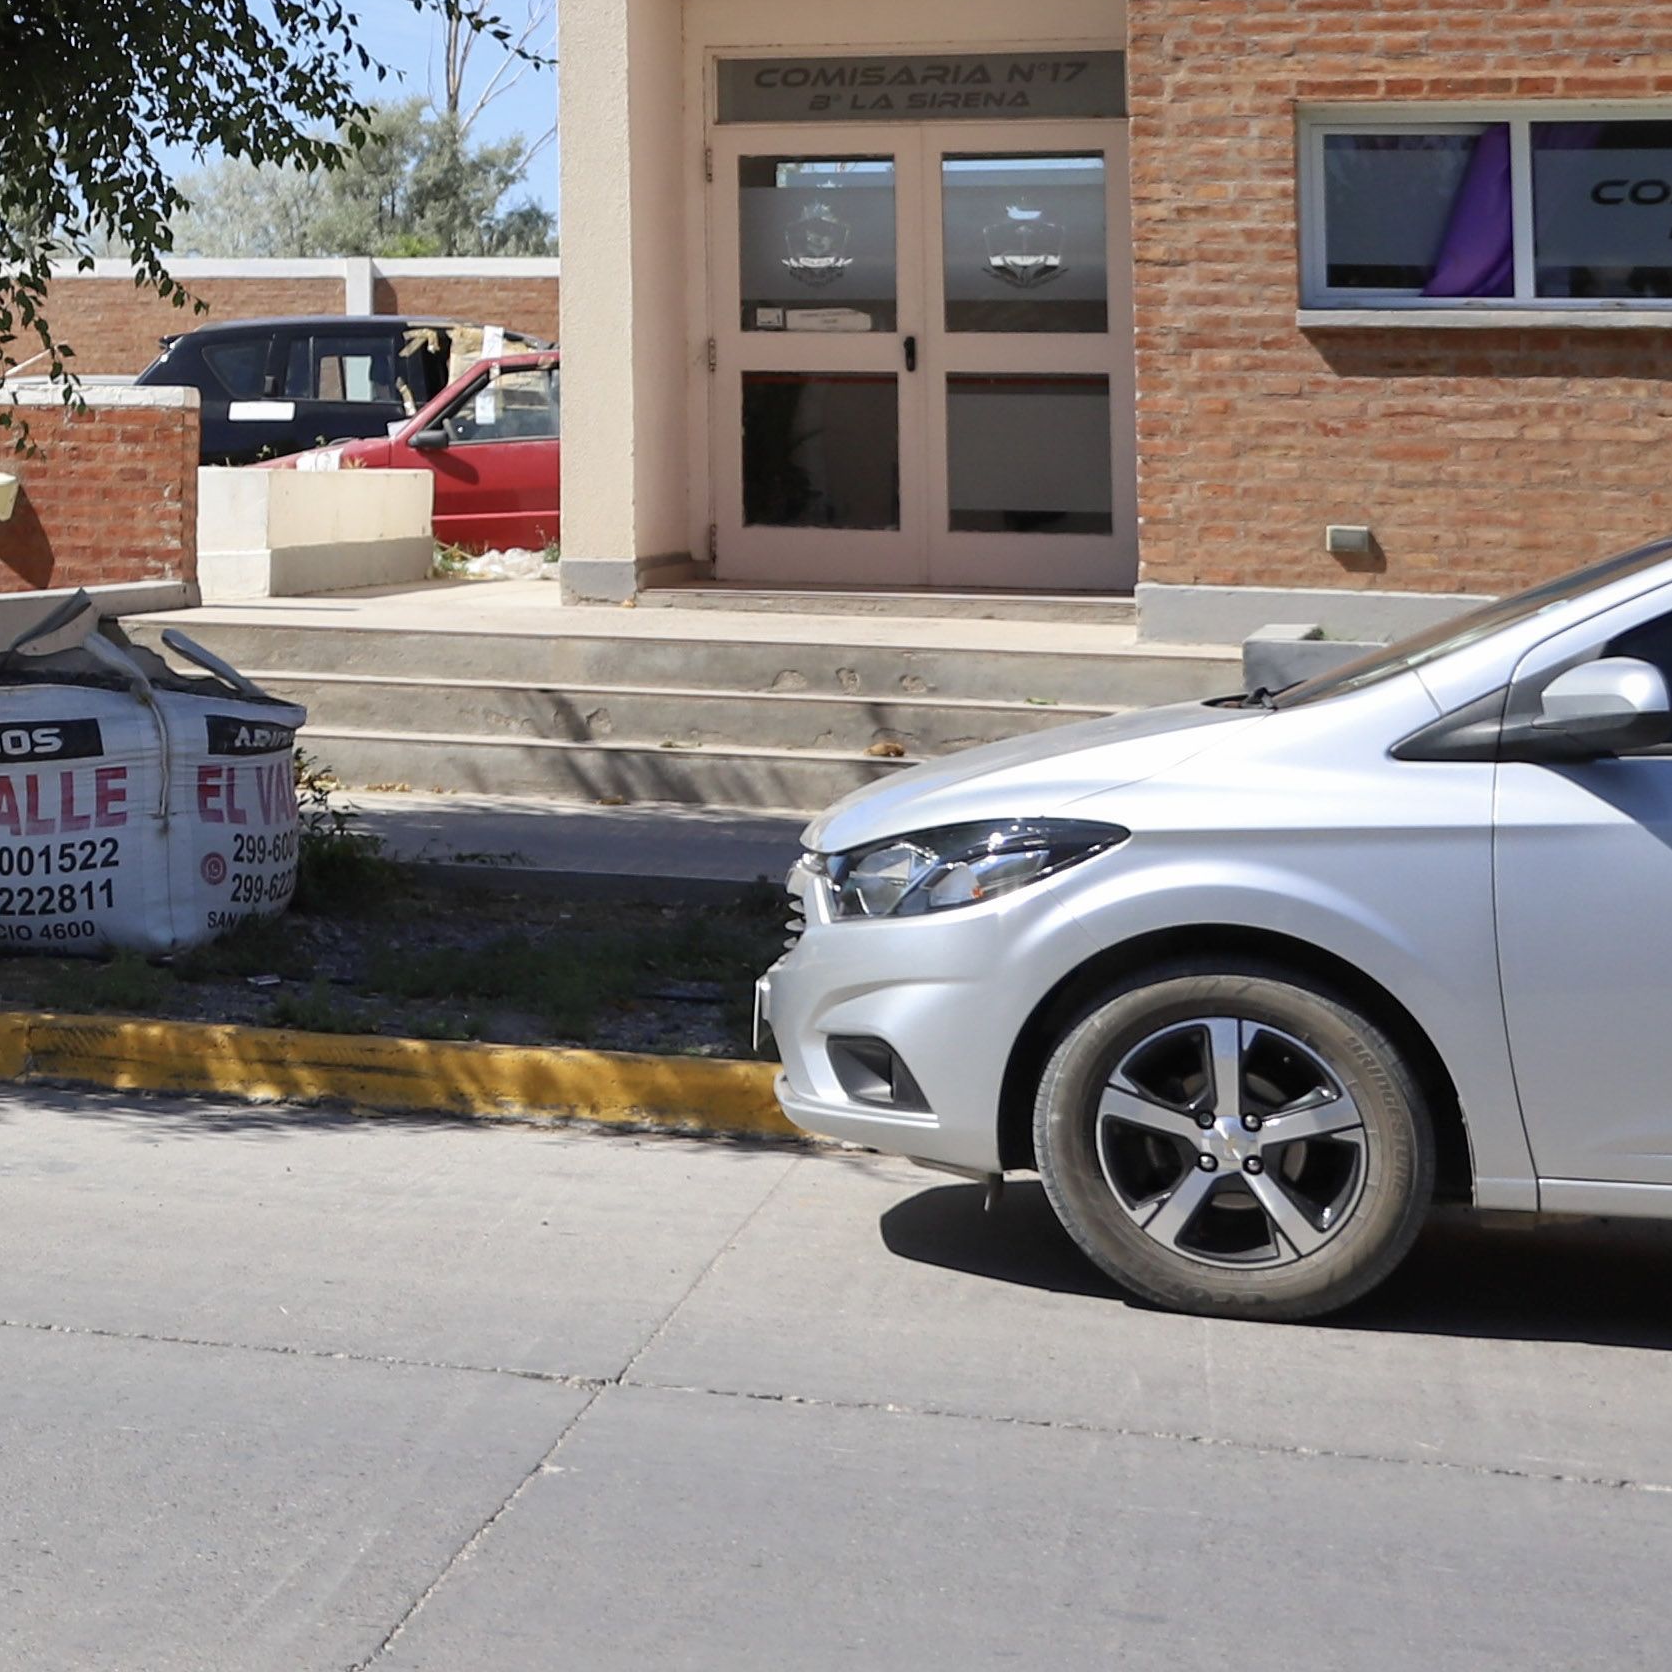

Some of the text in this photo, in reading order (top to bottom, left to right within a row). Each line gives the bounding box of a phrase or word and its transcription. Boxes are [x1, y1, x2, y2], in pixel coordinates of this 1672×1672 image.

[755, 64, 991, 88] COMISARIA
[851, 92, 894, 110] LA
[905, 90, 1030, 109] SIRENA
[1591, 178, 1672, 205] CO
[197, 764, 247, 825] EL
[39, 920, 96, 941] 4600
[207, 910, 237, 929] SAN
